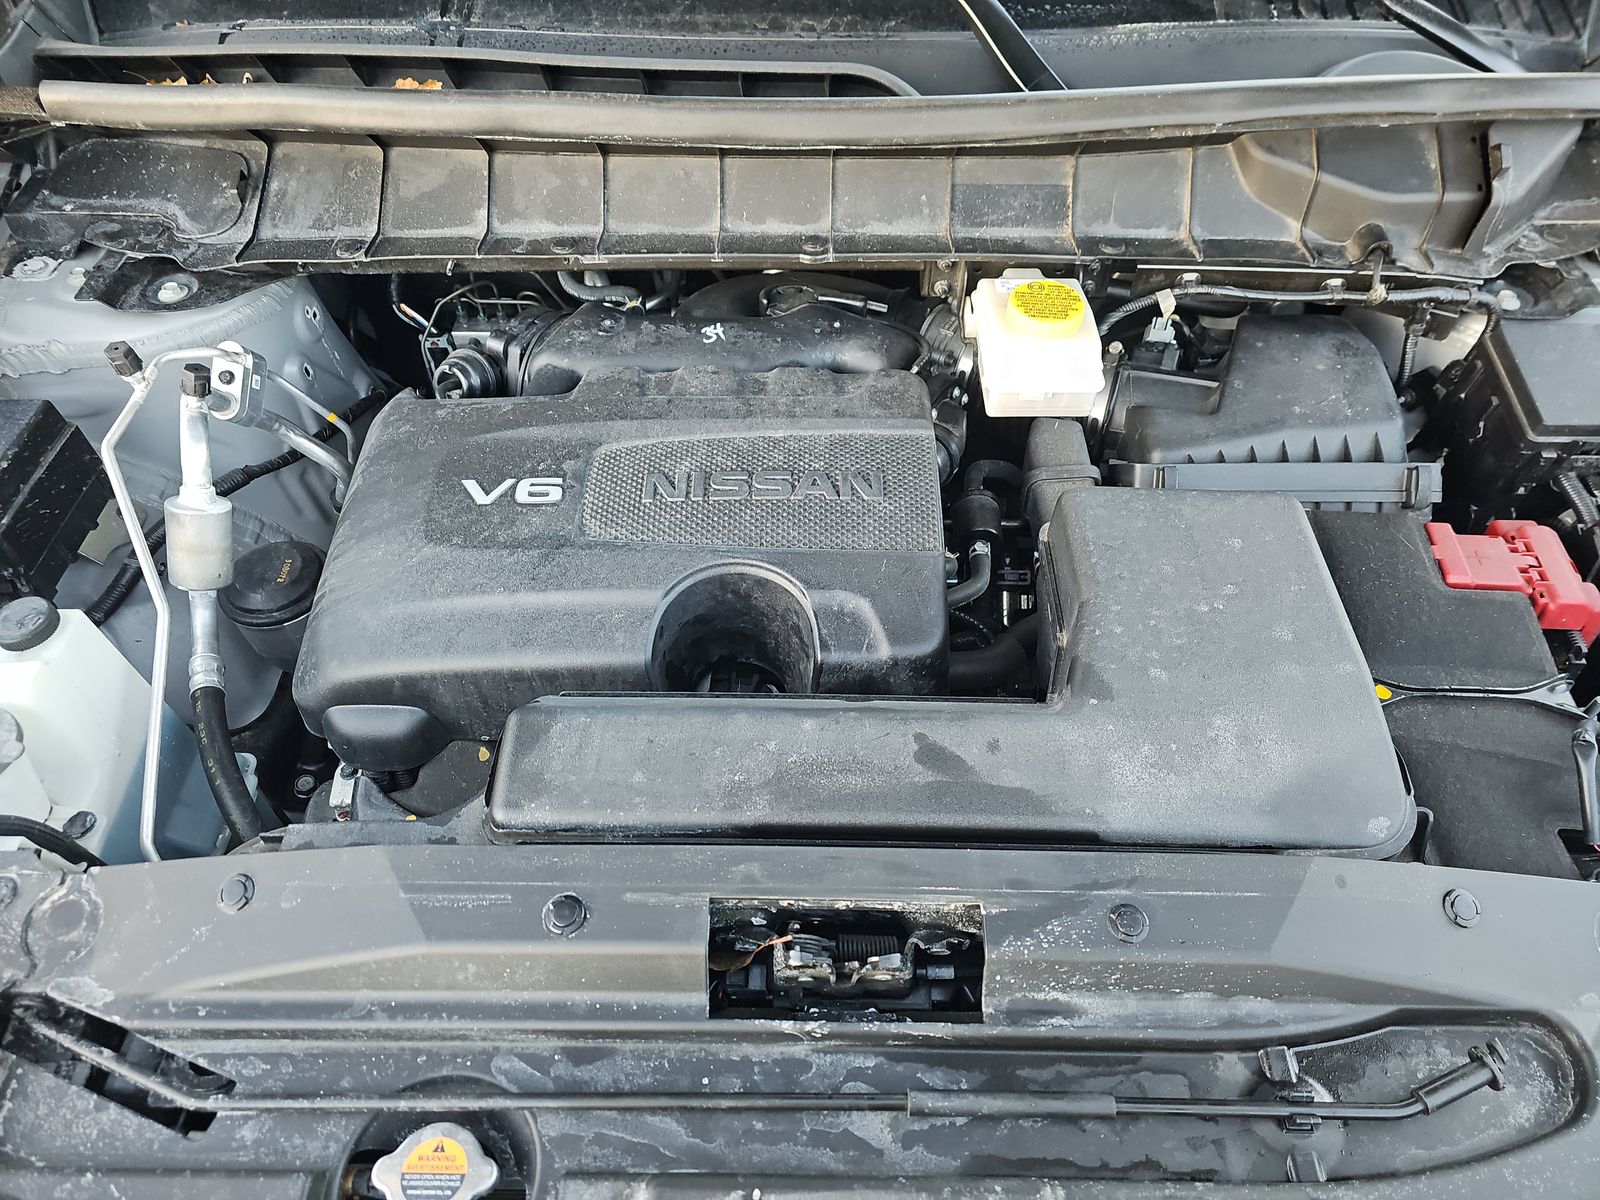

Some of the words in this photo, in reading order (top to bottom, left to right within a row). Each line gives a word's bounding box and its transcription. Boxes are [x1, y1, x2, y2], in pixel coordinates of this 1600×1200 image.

[701, 322, 726, 344] 34
[461, 477, 564, 505] V6
[643, 470, 885, 501] NISSAN
[406, 1164, 465, 1172] AVERTISSEMENT
[418, 1154, 457, 1163] WARNING
